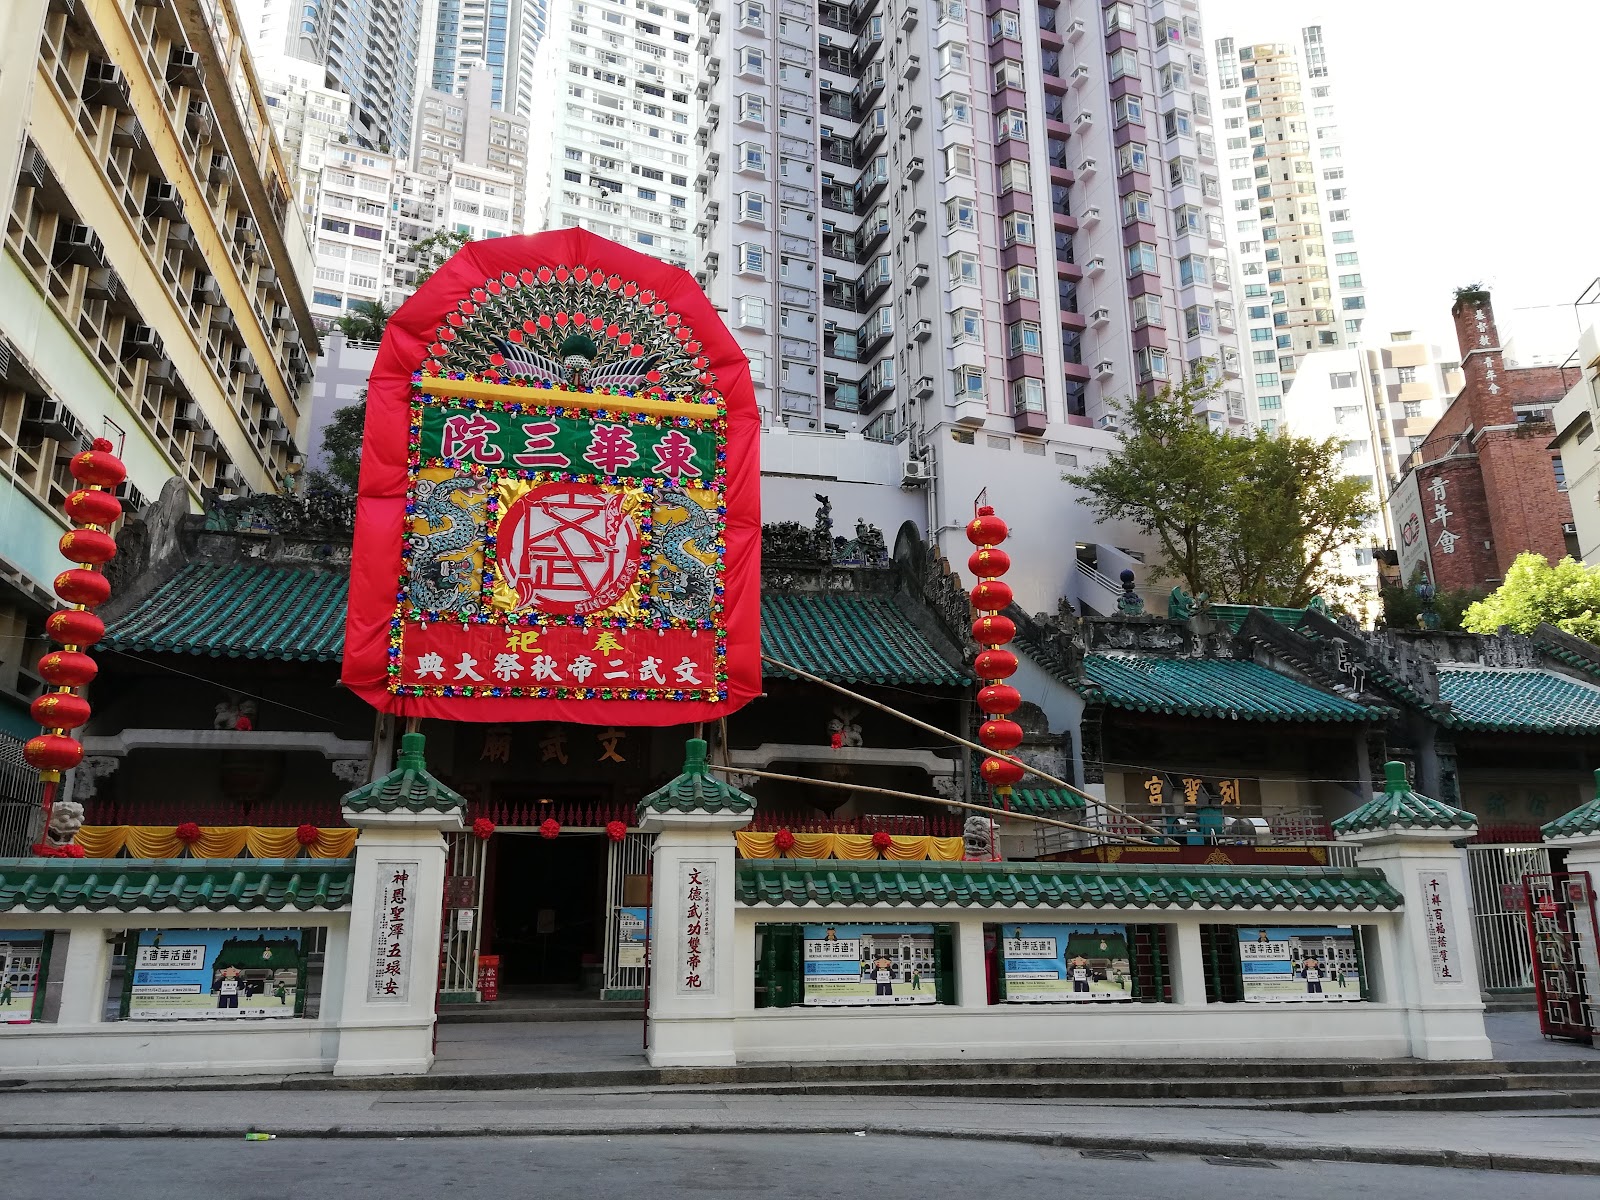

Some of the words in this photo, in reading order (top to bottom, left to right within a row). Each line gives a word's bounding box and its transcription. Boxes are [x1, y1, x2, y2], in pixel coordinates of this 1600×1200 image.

[1474, 309, 1491, 346] 基督教
[1484, 356, 1500, 395] 青年會
[441, 414, 701, 480] 東華三院
[1427, 476, 1461, 554] 青年會
[574, 589, 618, 614] SINCE
[505, 629, 624, 656] 奉祀
[414, 653, 702, 685] 文武二帝秋祭大典
[1144, 775, 1241, 809] 列聖宮
[383, 869, 409, 996] 神恩聖澤五環安
[686, 867, 703, 989] 文德武功雙帝祀
